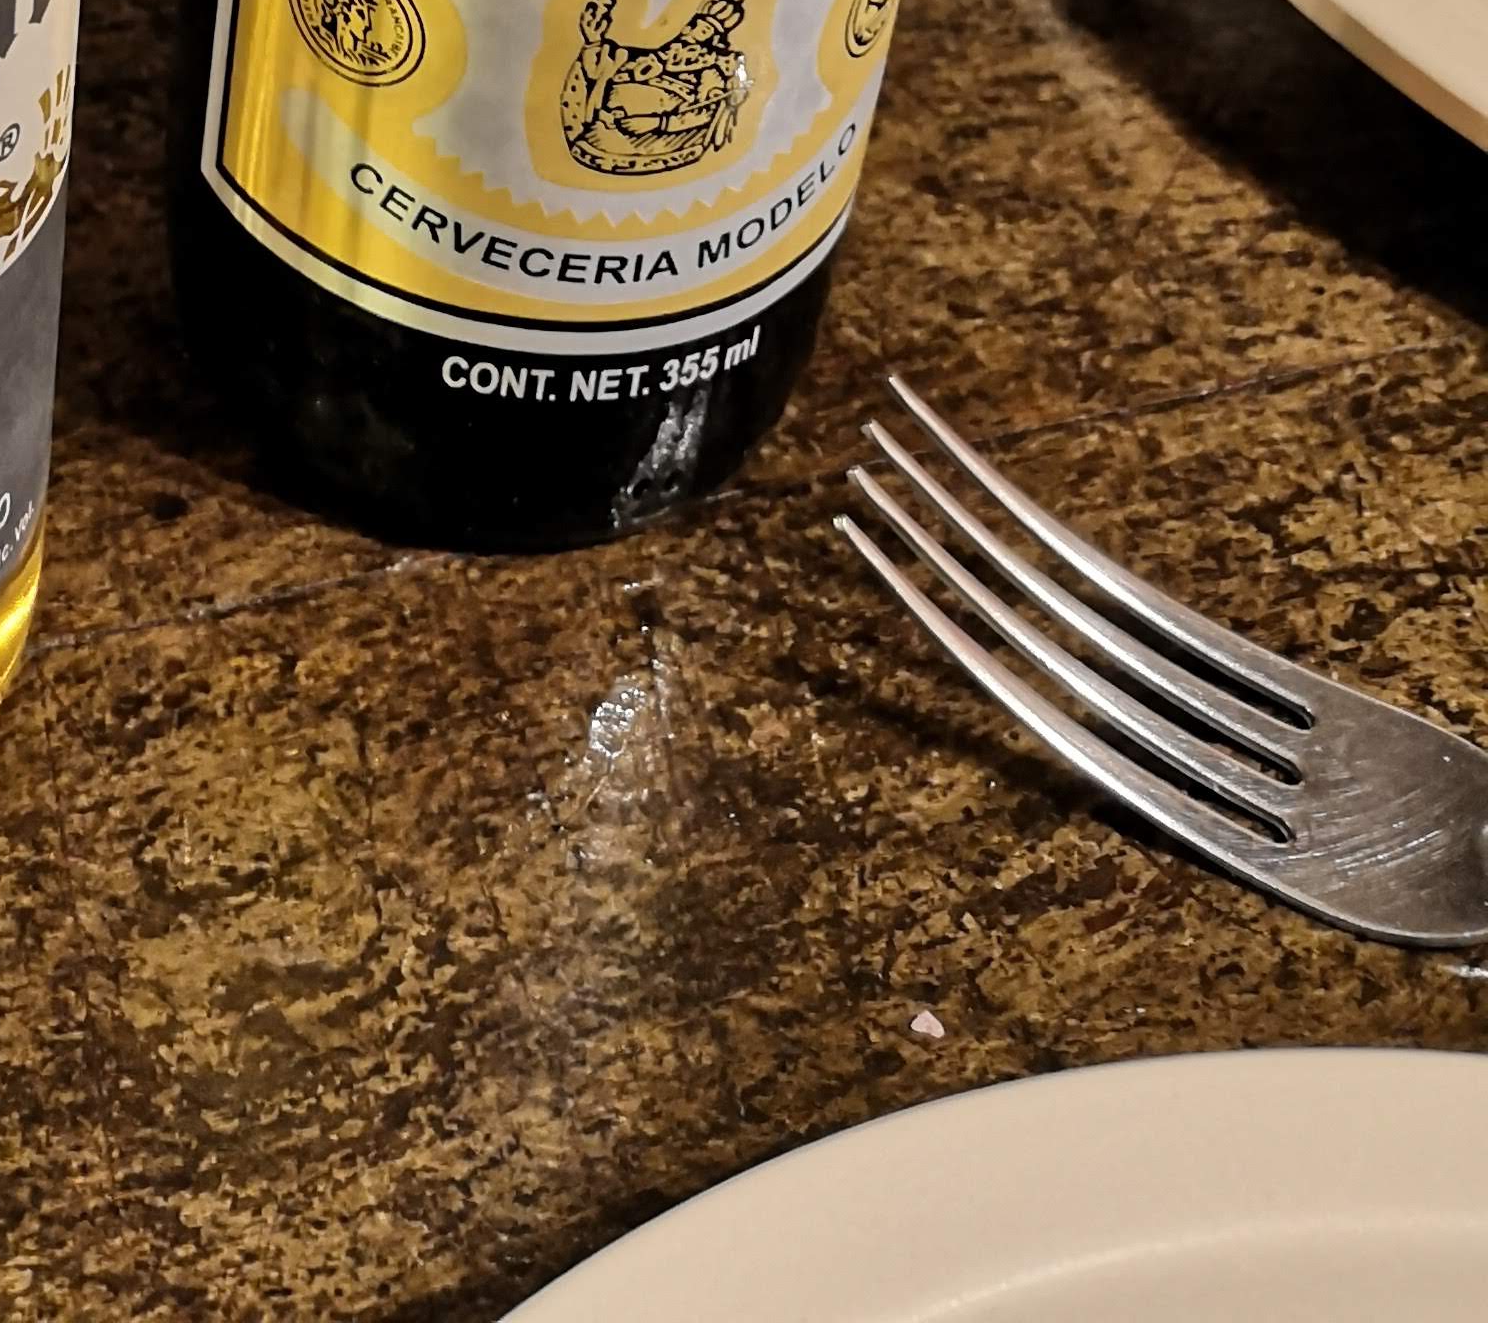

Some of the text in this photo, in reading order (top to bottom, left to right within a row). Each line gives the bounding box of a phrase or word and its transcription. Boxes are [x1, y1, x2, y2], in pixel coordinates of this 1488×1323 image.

[349, 121, 857, 286] CERVECERIA MODELO
[441, 355, 557, 402] CONT.
[569, 364, 651, 403] NET.
